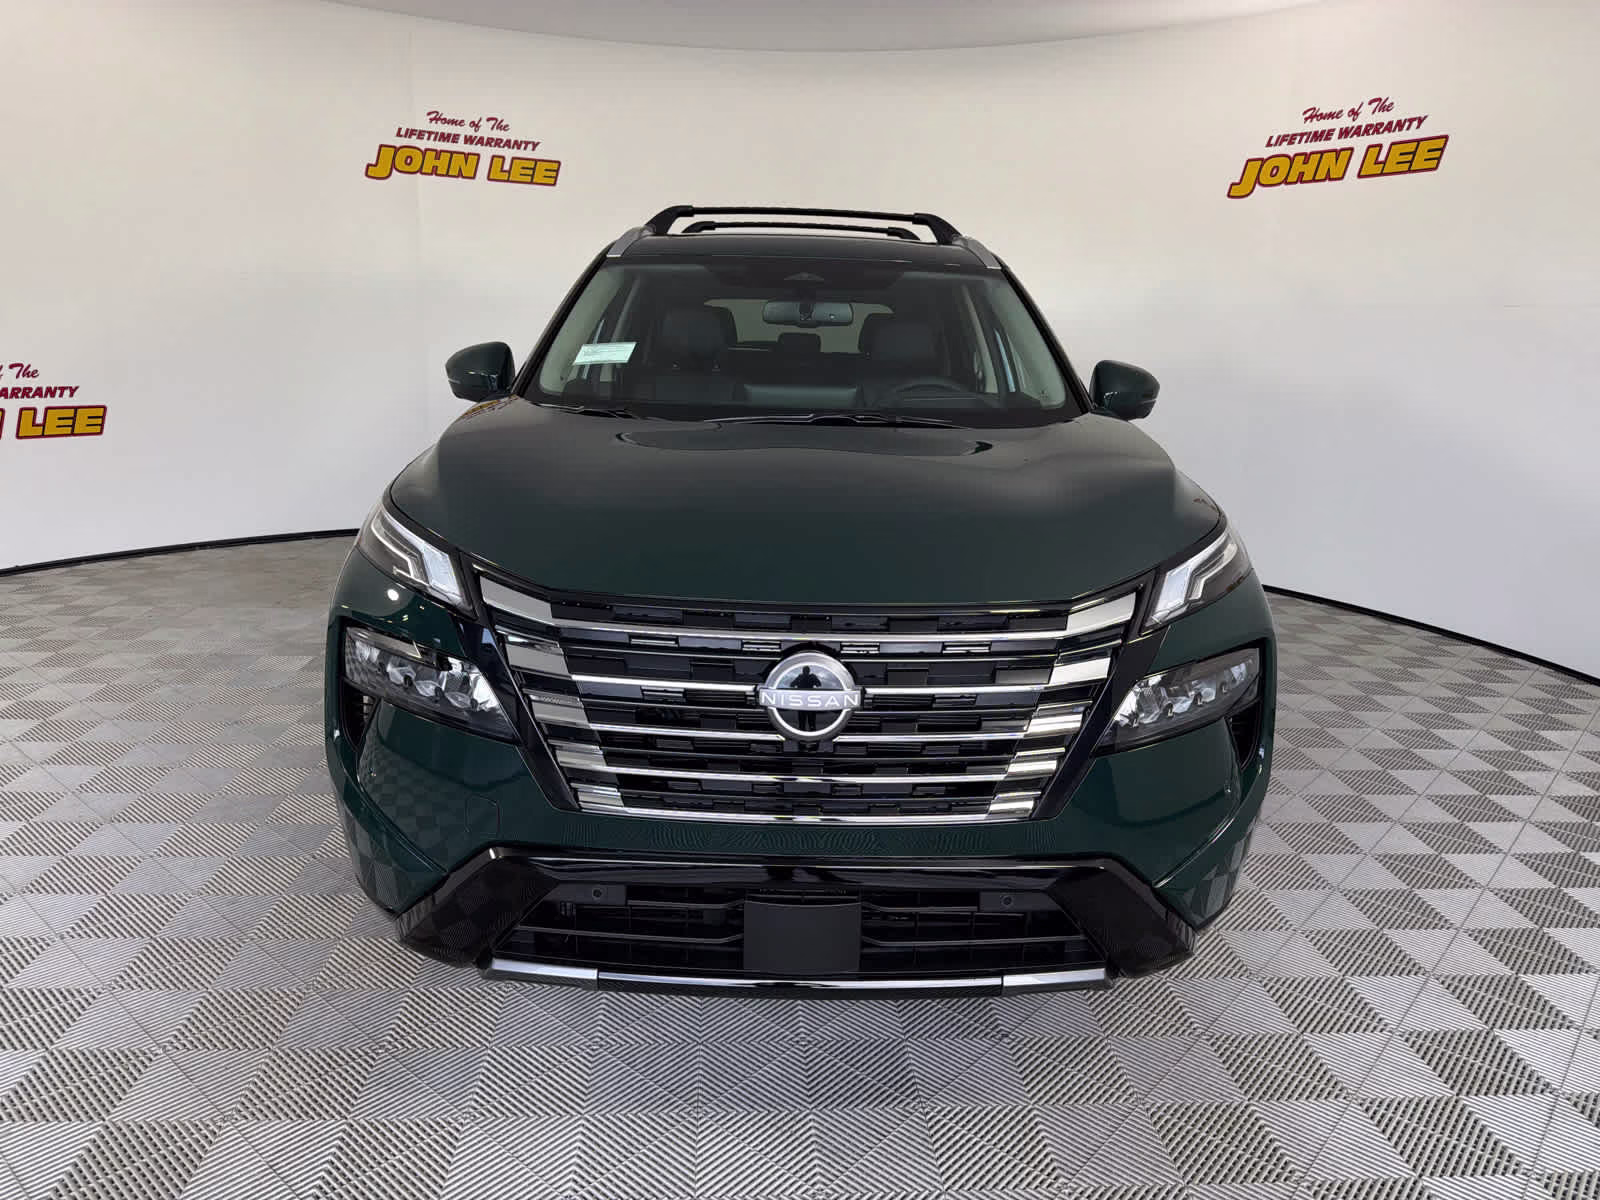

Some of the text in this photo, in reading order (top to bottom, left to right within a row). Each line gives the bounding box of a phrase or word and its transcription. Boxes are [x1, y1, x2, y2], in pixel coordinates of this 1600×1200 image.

[427, 110, 510, 132] Home of The
[1302, 97, 1394, 124] Home of The
[396, 127, 540, 151] LIFETIME WARRANTY
[1265, 115, 1428, 148] LIFETIME WARRANTY
[365, 144, 561, 187] JOHN LEE
[1227, 135, 1449, 199] JOHN LEE
[8, 363, 40, 379] The
[0, 385, 80, 399] ARRANTY
[16, 405, 107, 440] LEE
[761, 691, 859, 708] NISSAN
